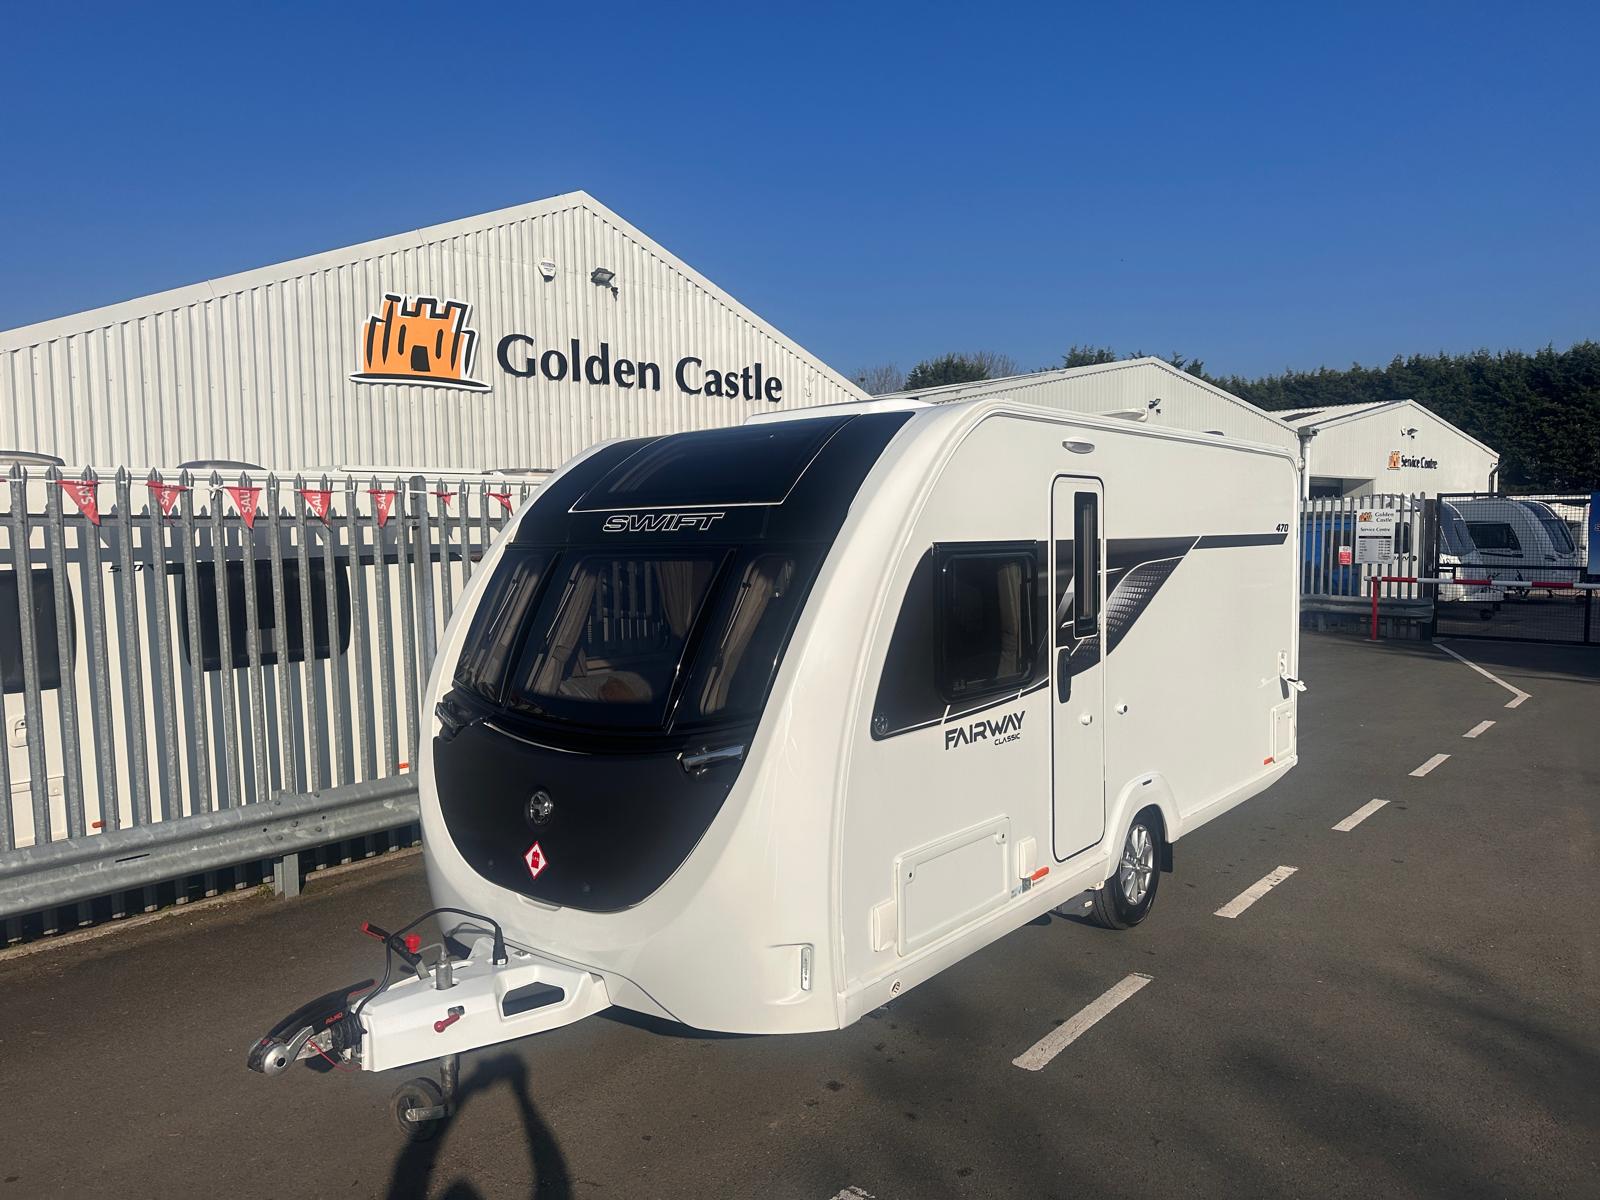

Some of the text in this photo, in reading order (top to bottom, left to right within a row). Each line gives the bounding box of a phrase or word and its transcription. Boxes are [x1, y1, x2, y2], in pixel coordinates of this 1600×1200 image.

[497, 333, 783, 403] Golden Castle
[1401, 454, 1438, 469] Service Centre
[602, 511, 726, 532] SWIFT
[1275, 523, 1289, 532] 470
[945, 710, 1026, 751] FAIRWAY
[994, 732, 1021, 746] CLASSIC
